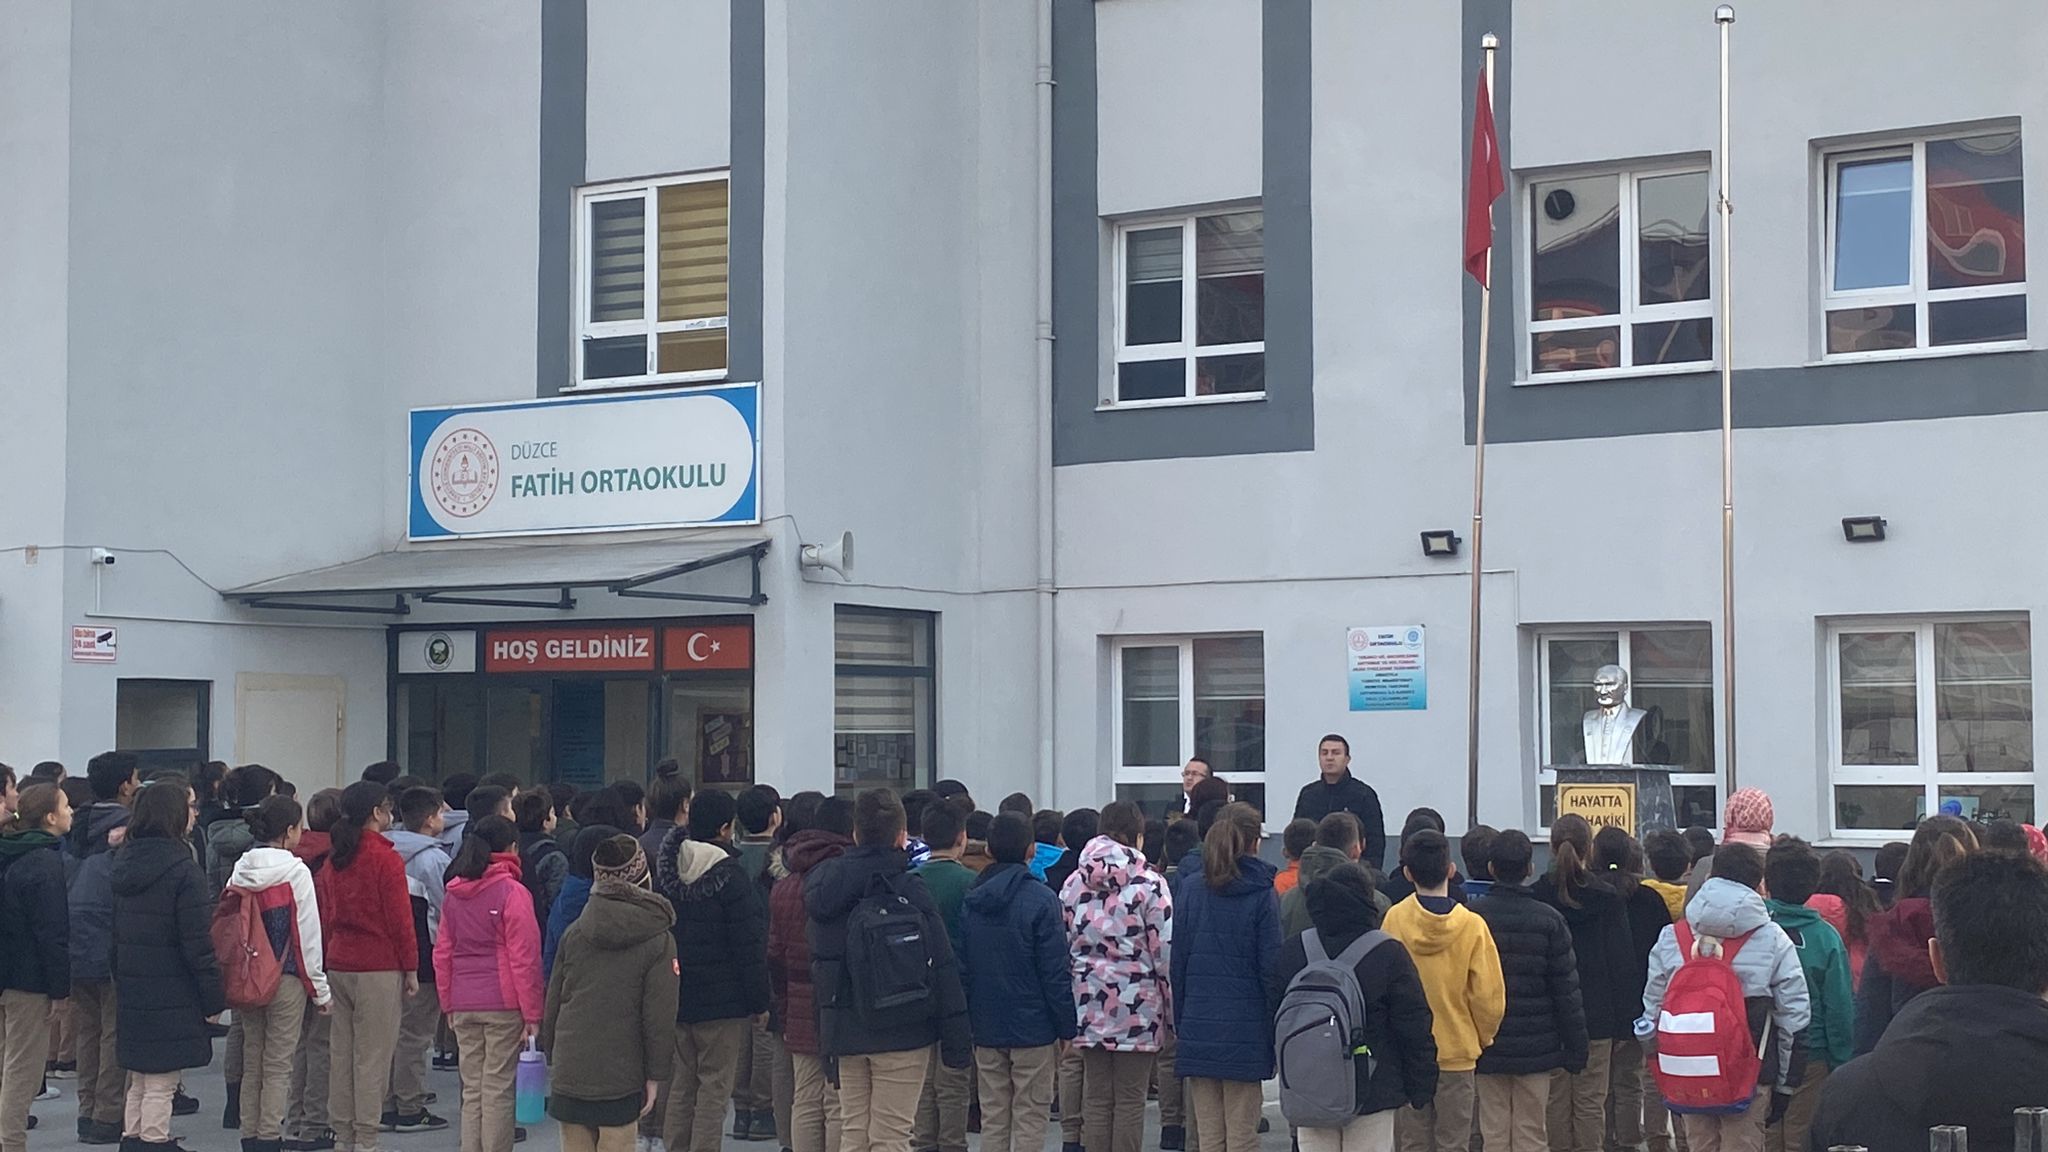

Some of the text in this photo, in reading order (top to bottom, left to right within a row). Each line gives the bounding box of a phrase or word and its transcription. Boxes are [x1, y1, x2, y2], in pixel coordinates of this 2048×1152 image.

[511, 441, 558, 460] DÜZCE
[511, 467, 574, 498] FATİH
[580, 463, 726, 494] ORTAOKULU
[493, 634, 649, 664] HOŞ GELDİNİZ
[1570, 795, 1622, 808] HAYATTA
